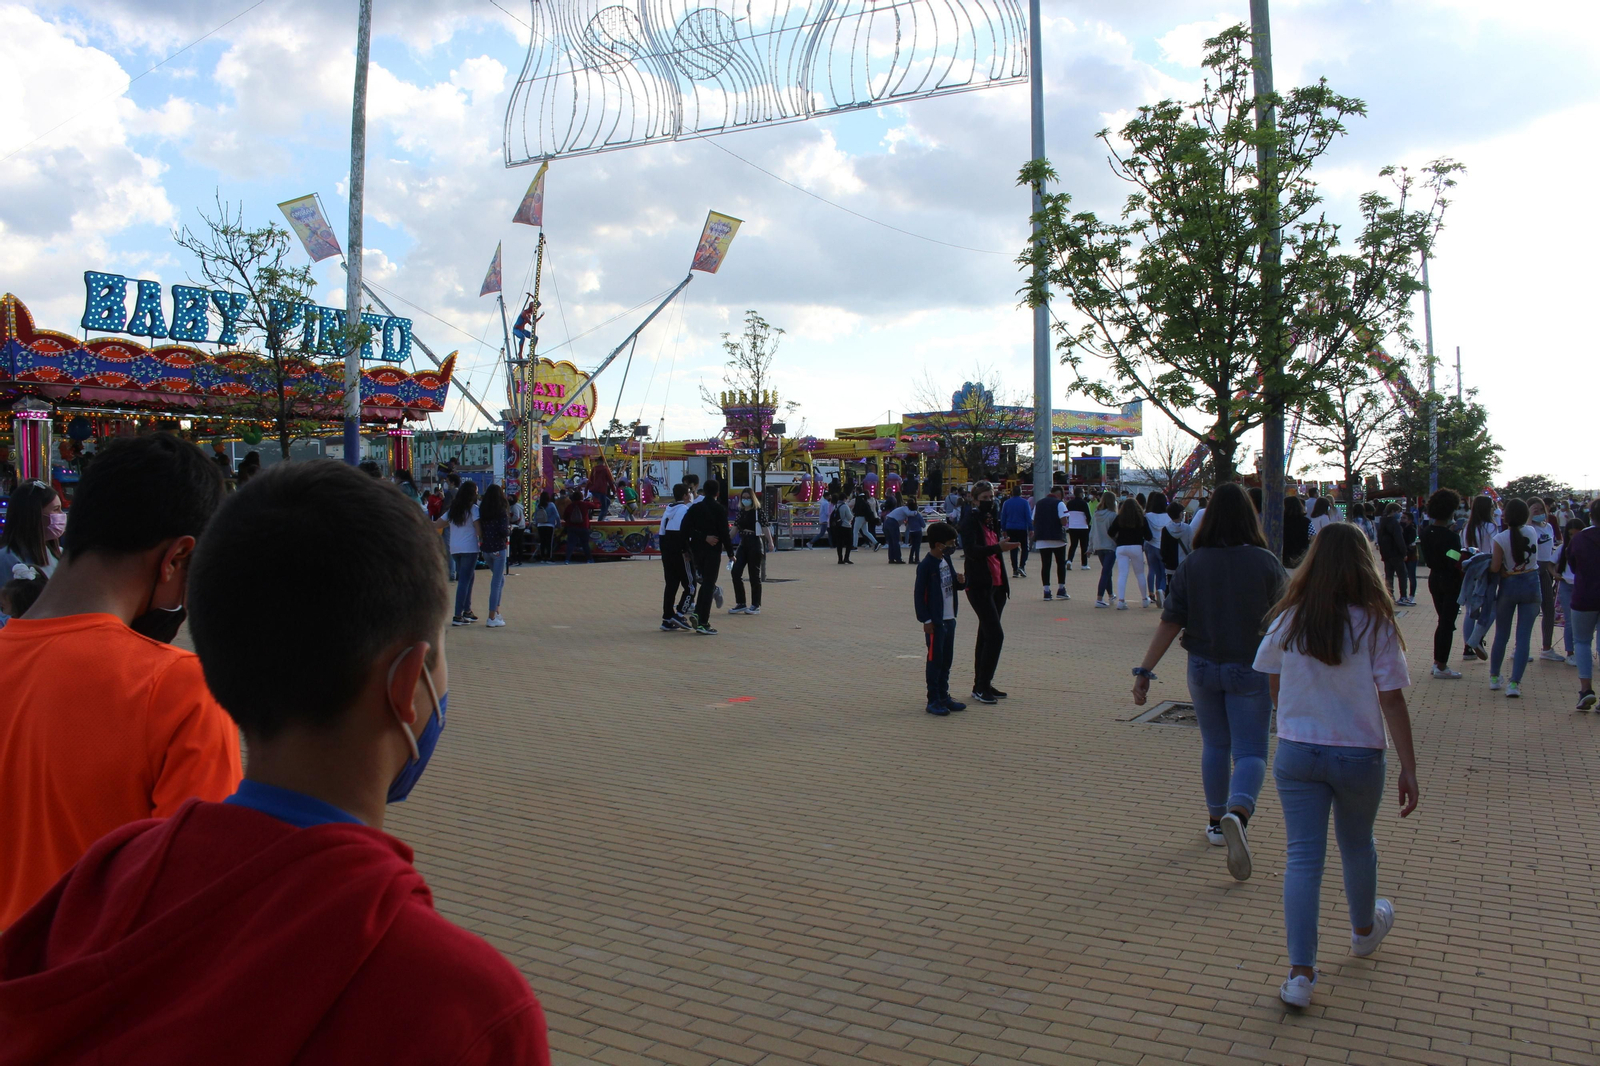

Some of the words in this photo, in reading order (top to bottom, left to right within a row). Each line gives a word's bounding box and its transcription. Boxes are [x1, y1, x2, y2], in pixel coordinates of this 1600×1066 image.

[81, 270, 248, 345] BABY
[265, 299, 413, 362] PINTO
[533, 399, 588, 418] DANCE
